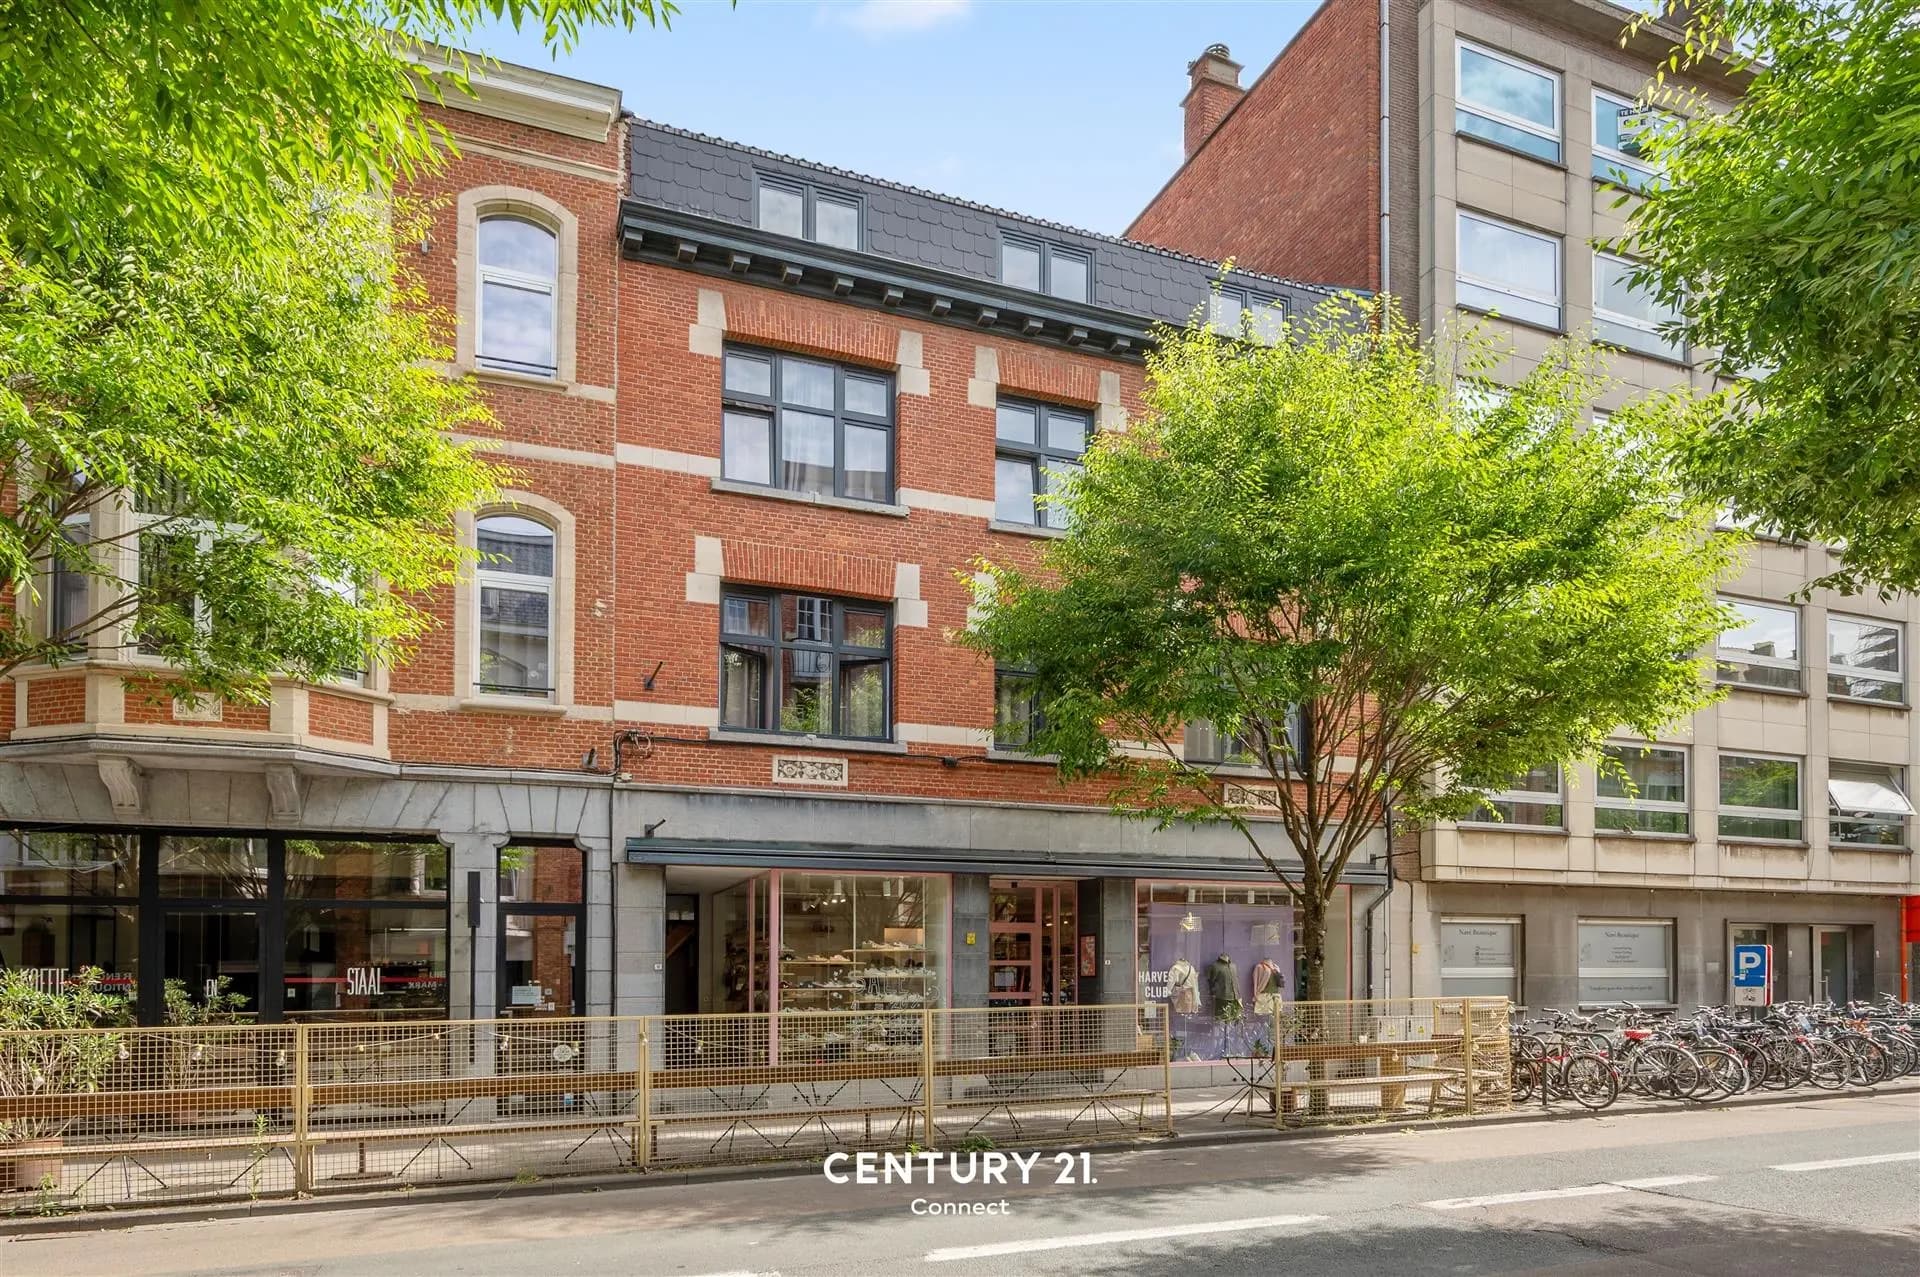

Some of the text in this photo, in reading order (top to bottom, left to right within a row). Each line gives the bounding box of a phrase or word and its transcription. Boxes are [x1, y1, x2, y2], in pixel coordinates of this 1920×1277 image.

[1739, 952, 1761, 969] P
[206, 979, 218, 997] EN
[347, 967, 384, 995] STAAL
[1145, 986, 1168, 998] CLUB
